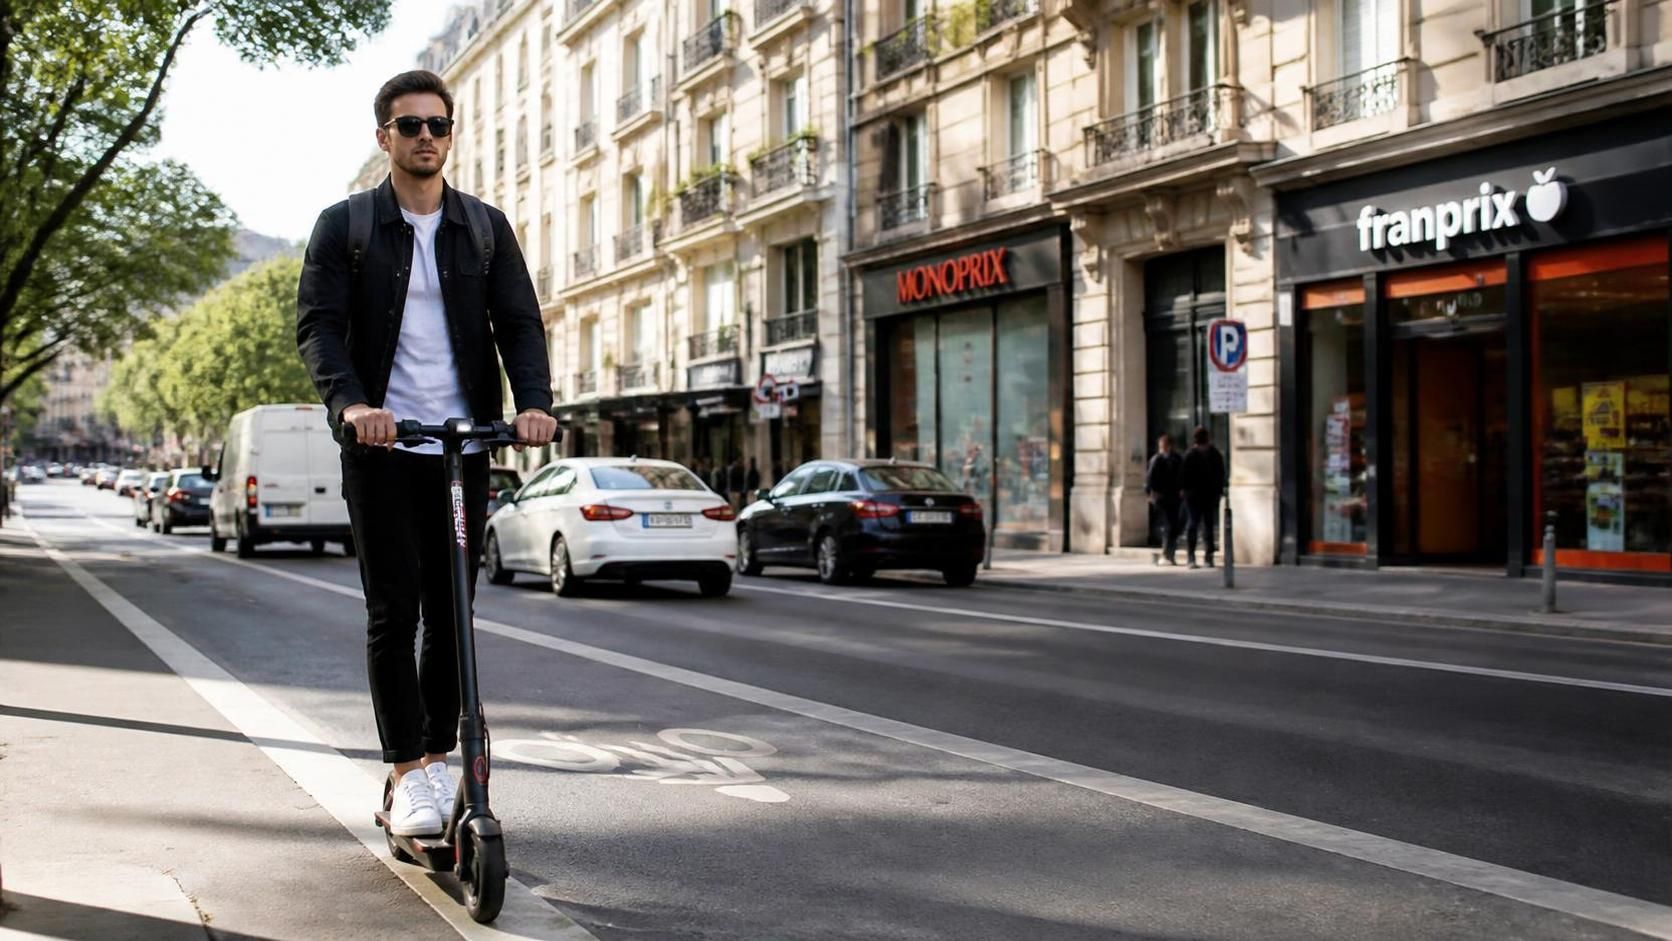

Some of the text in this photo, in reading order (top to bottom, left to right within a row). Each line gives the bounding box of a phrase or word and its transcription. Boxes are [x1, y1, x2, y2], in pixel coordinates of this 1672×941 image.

[1356, 181, 1518, 252] franprix
[896, 246, 1008, 305] MONOPRIX
[1219, 324, 1240, 365] P
